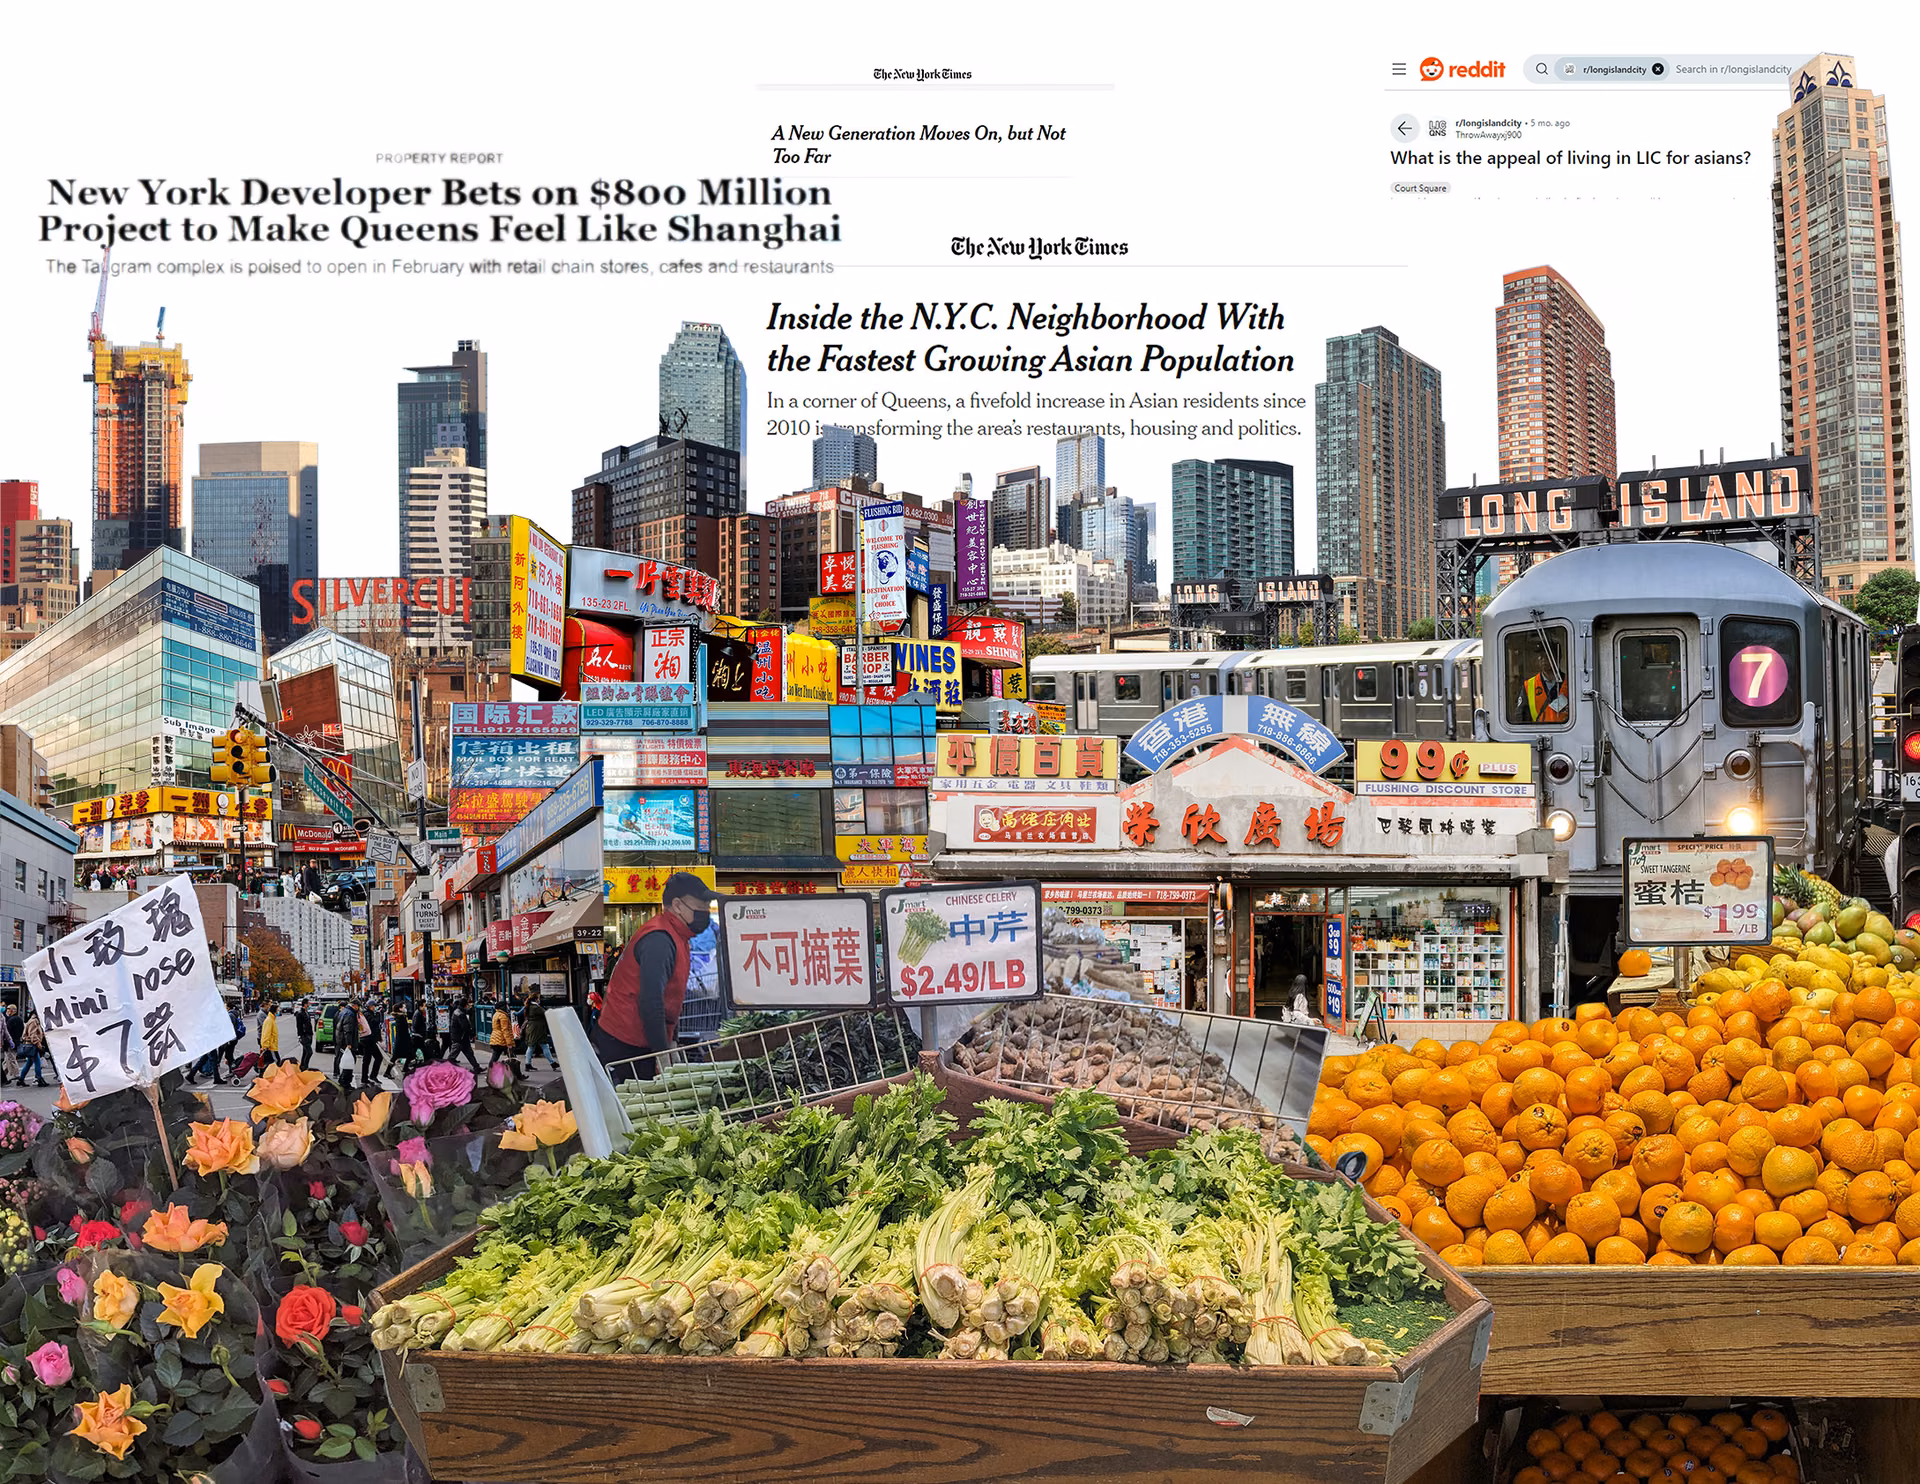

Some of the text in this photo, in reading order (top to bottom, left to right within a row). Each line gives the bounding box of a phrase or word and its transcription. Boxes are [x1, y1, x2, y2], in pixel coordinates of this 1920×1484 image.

[1464, 468, 1801, 537] LONG ISLAND
[864, 504, 903, 519] FLUSHING BID
[866, 534, 904, 545] WELCOME TO
[871, 542, 899, 551] FLUSHING
[867, 586, 905, 594] DESTINATION
[1177, 580, 1320, 604] LONG ISLAND
[582, 597, 612, 608] 135-23
[651, 628, 685, 648] 正宗
[1741, 653, 1773, 699] 7
[453, 704, 577, 725] 国际汇款
[586, 708, 604, 717] LED
[164, 717, 182, 727] Sub
[185, 721, 216, 734] Image
[1138, 702, 1332, 757] 香港 無線
[457, 740, 576, 756] 信箱出租
[1153, 724, 1316, 765] 718-353-5255 718-886-6866
[946, 735, 1104, 778] 平價百貨
[848, 768, 892, 779] 第一保險
[1482, 764, 1517, 773] PLUS
[940, 780, 1108, 791] 家用五金 電器 文具 鞋類
[1365, 784, 1527, 795] FLUSHING DISCOUNT STORE
[1122, 801, 1346, 848] 榮欣廣場
[434, 830, 448, 839] Main
[1640, 864, 1691, 874] SWEET TANGERINE
[946, 891, 1017, 906] CHINESE CELERY
[1156, 890, 1197, 901] 718-799-0373
[1633, 879, 1705, 906] 蜜桔
[577, 928, 602, 937] 39-22
[949, 910, 1028, 946] 中芹
[740, 927, 863, 987] 不可摘葉
[133, 948, 195, 1001] rose
[900, 959, 1026, 1000] $2.49/LB
[43, 988, 109, 1032] Mini
